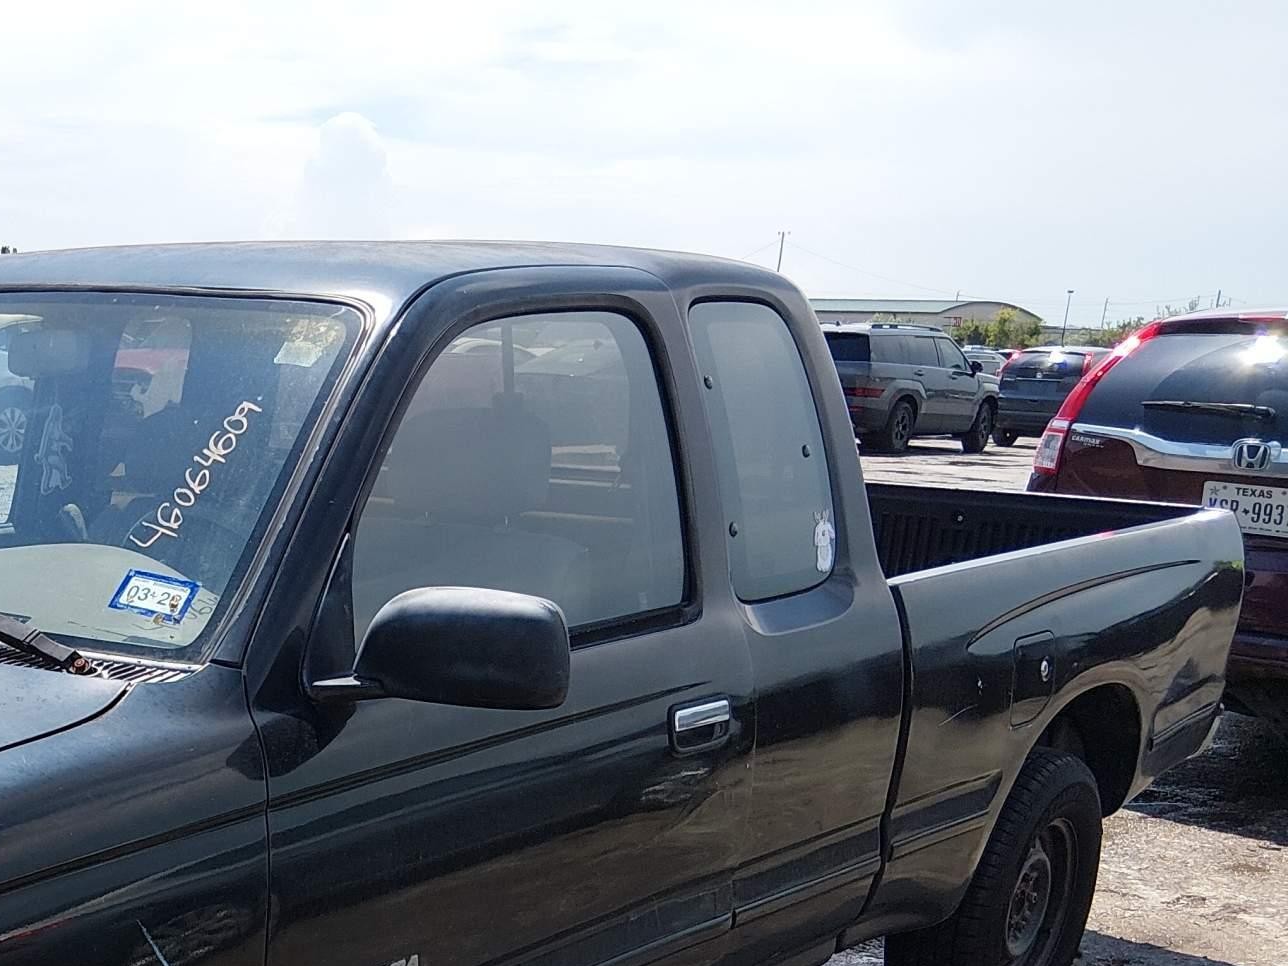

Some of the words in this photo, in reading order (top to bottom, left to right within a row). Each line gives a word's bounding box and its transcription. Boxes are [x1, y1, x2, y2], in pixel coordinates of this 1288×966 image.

[129, 400, 262, 548] 46064609
[1234, 487, 1273, 499] TEXAS
[1250, 502, 1288, 526] 993
